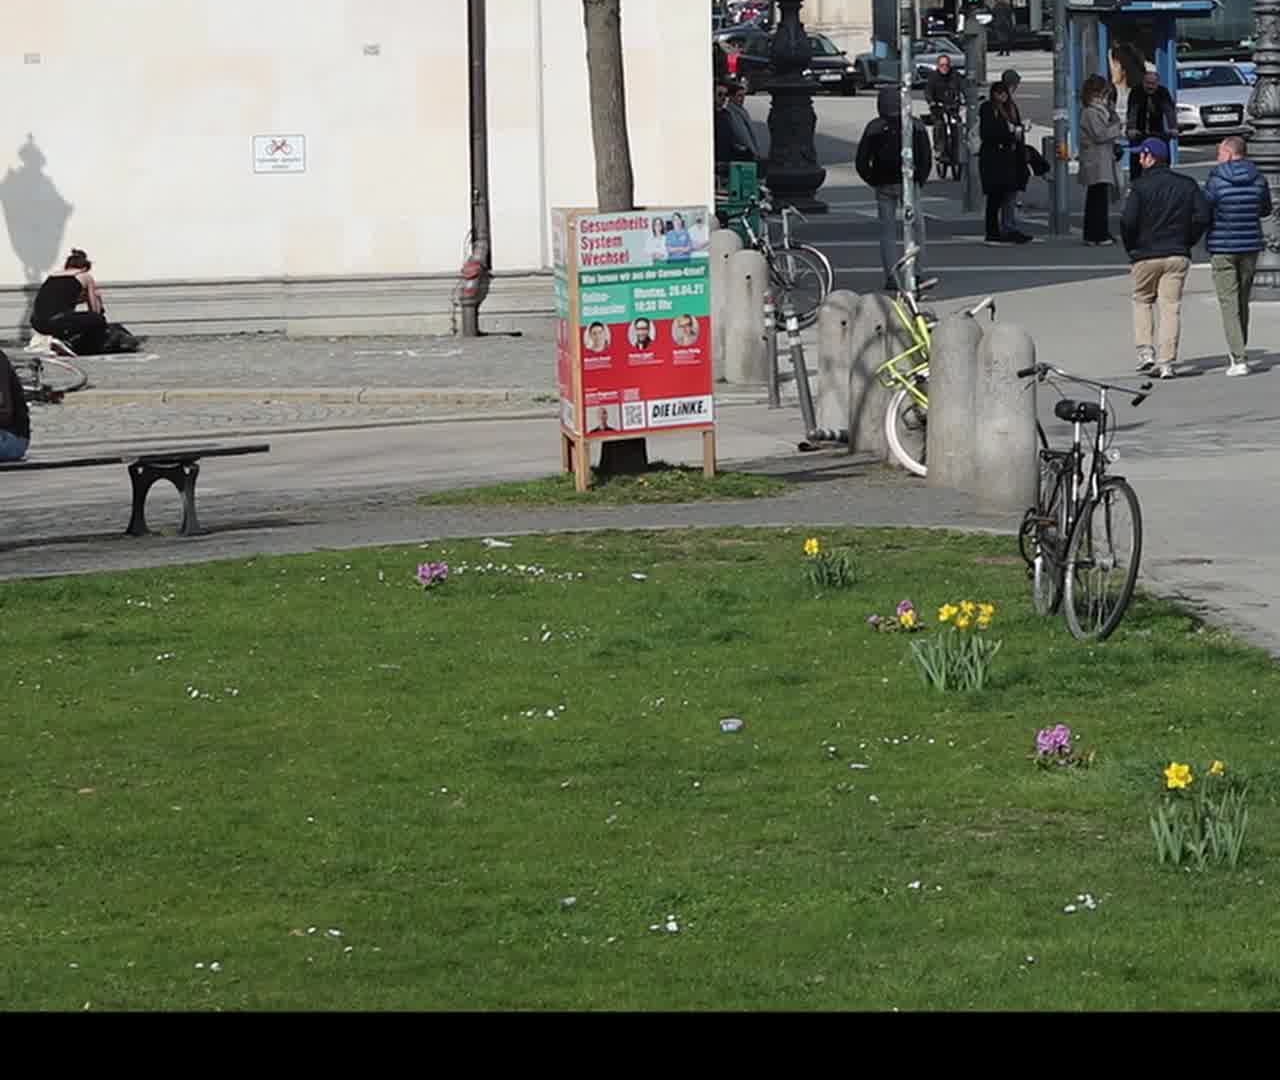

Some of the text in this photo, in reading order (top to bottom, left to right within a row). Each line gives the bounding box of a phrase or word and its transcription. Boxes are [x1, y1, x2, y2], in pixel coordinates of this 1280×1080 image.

[580, 216, 649, 233] Gesundheits
[581, 235, 623, 251] System
[581, 250, 629, 265] Wechsel
[652, 403, 670, 418] DIE
